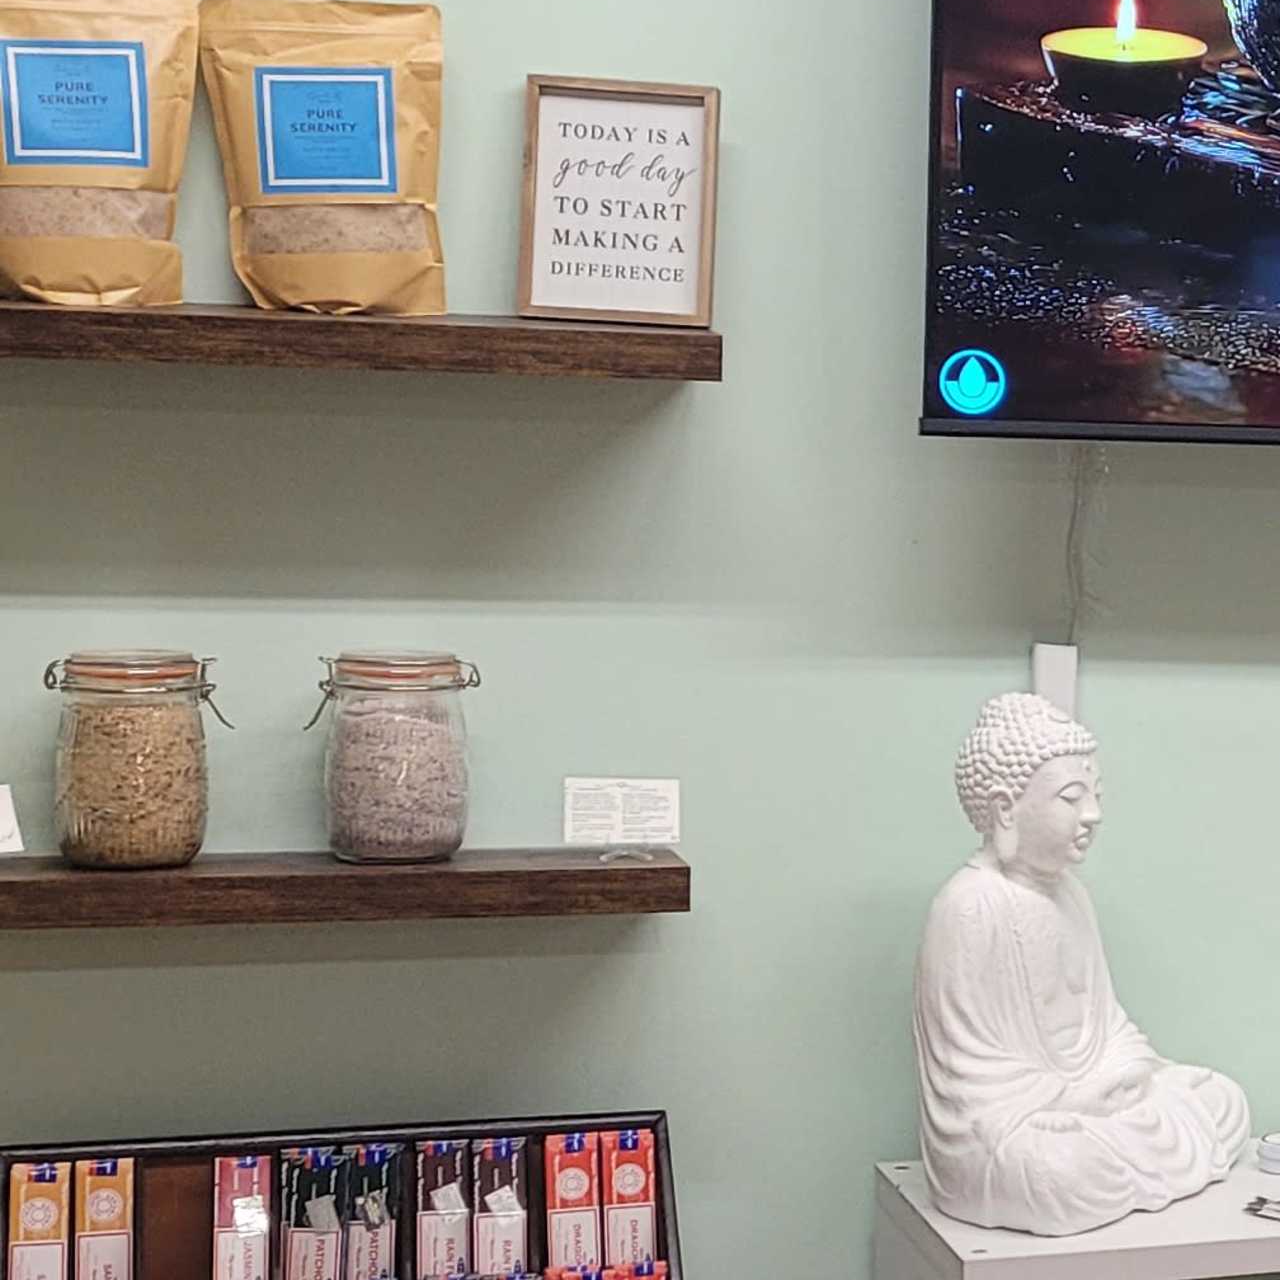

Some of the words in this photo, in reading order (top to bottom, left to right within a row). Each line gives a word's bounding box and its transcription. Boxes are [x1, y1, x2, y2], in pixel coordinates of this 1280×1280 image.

[37, 93, 109, 105] SERENITY
[54, 81, 95, 93] PURE
[305, 108, 343, 120] PURE
[289, 122, 357, 133] SERENITY
[558, 122, 638, 143] TODAY
[647, 128, 668, 145] IS
[675, 131, 691, 147] A
[552, 151, 636, 189] good
[639, 154, 697, 198] day
[553, 196, 589, 216] TO
[599, 198, 688, 222] START
[551, 228, 659, 252] MAKING
[668, 236, 685, 254] A
[550, 260, 685, 284] DIFFERENCE
